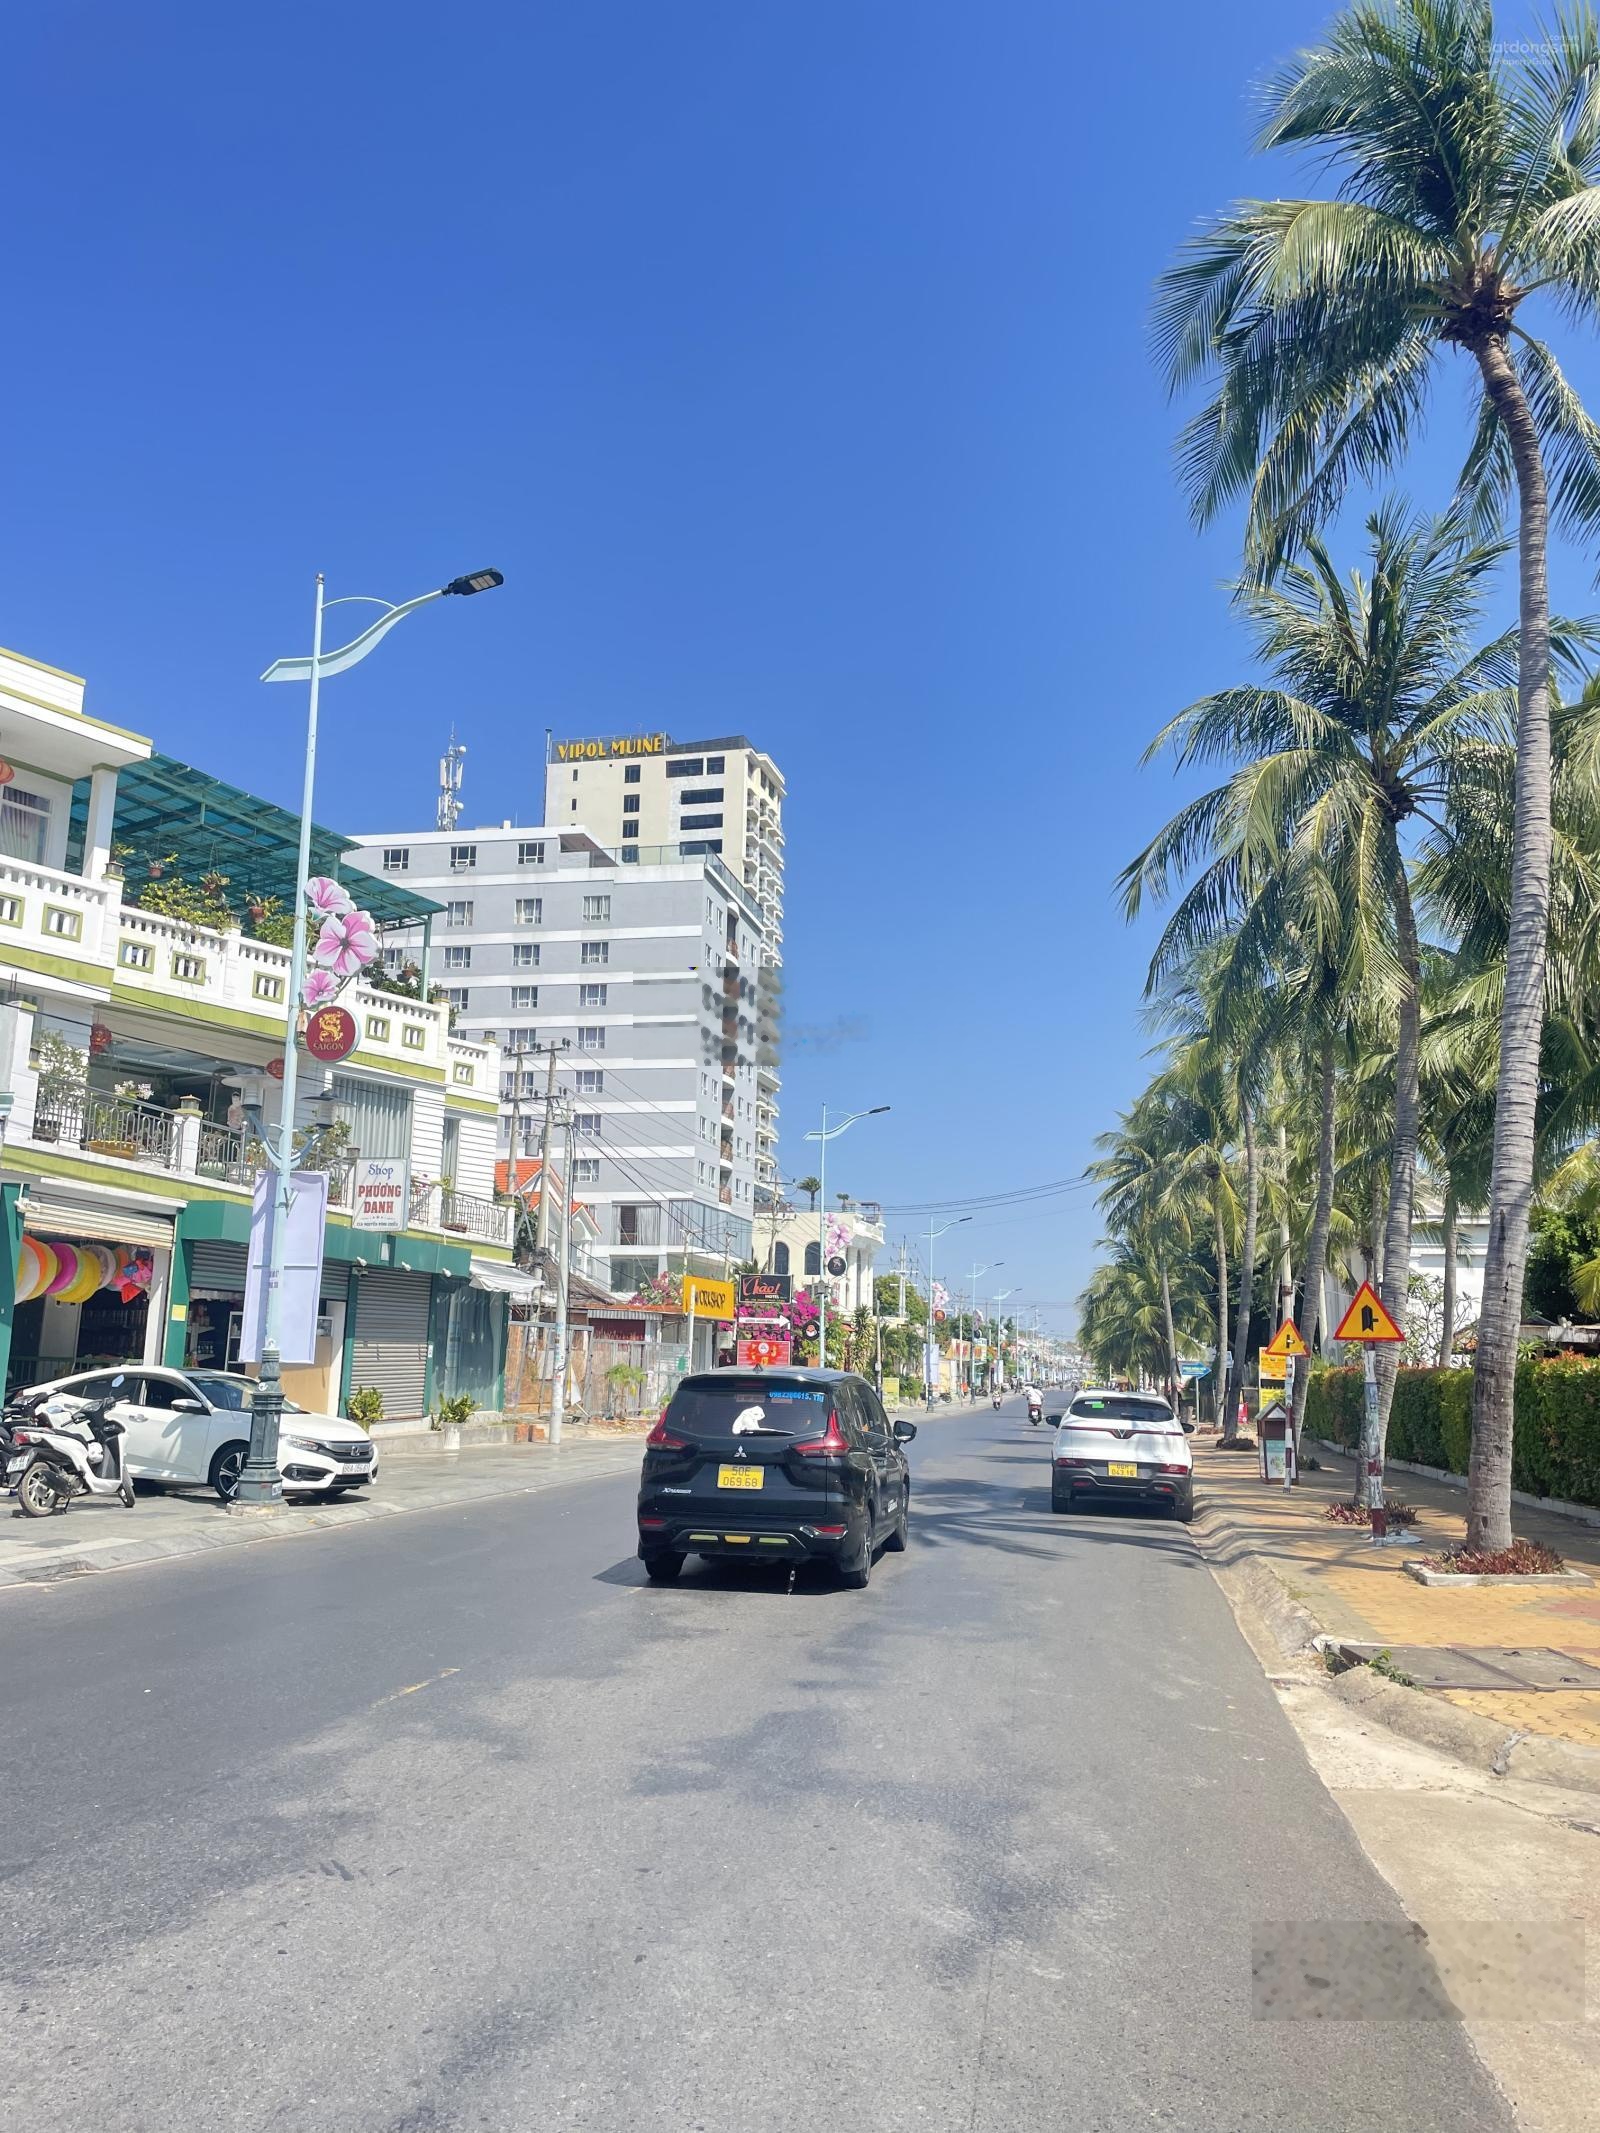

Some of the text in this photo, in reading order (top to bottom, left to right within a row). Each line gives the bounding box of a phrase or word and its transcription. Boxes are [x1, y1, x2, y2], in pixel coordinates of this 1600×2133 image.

[558, 735, 663, 759] VIPOL MUINE
[313, 1042, 344, 1050] SAIGON
[368, 1163, 394, 1180] Shop
[358, 1182, 402, 1198] PHƯƠNG
[363, 1201, 394, 1214] DANH
[732, 1466, 752, 1476] 50E
[722, 1477, 758, 1488] 069.68
